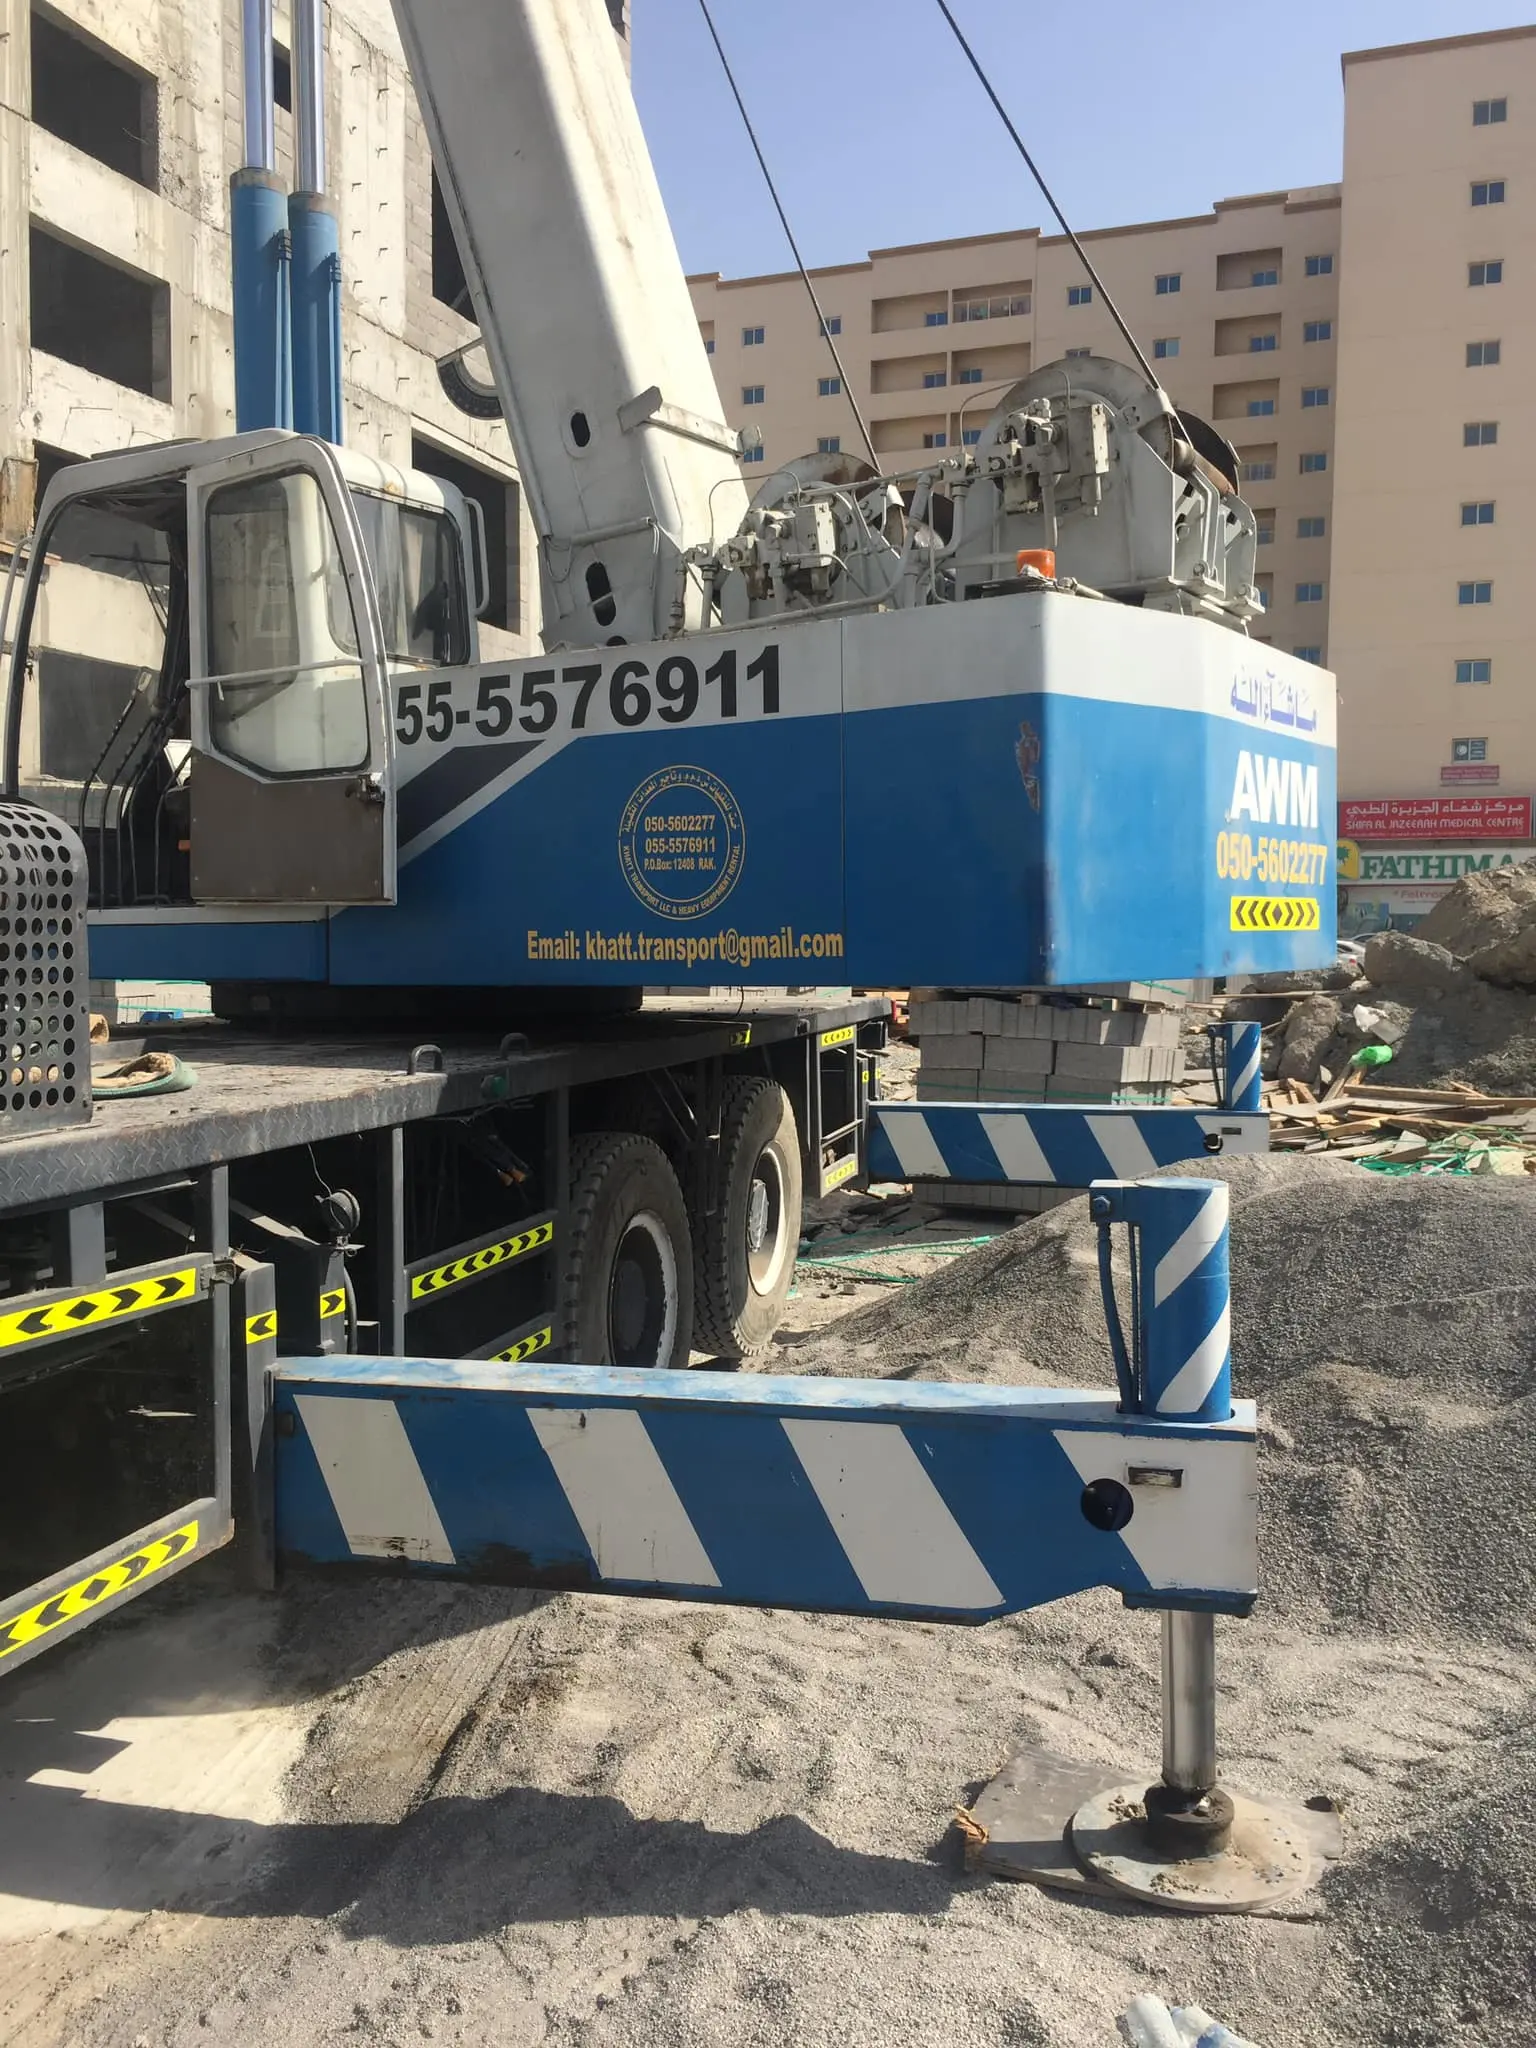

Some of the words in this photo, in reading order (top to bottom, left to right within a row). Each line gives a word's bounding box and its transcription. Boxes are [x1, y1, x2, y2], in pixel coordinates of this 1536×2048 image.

[1231, 749, 1318, 828] AWM
[1391, 801, 1438, 816] الجزيرة
[1484, 800, 1524, 814] مركز
[644, 815, 716, 833] 050-5602277
[1345, 820, 1373, 830] SHIFA
[1375, 820, 1387, 829] AL
[1388, 818, 1437, 829] JAZEERAH
[1440, 818, 1482, 828] MEDICAL
[1487, 817, 1524, 827] CENTRE
[645, 837, 716, 854] 055-5576911
[1216, 831, 1328, 886] 050-5602277
[629, 871, 660, 907] TRANSPORT
[659, 901, 671, 913] LLC
[678, 903, 700, 915] HEAVY
[700, 874, 732, 909] EQUIPMENT
[729, 843, 741, 876] RENTAL
[527, 930, 580, 960] Email:
[586, 927, 844, 968] khatt.transport@gmail.com
